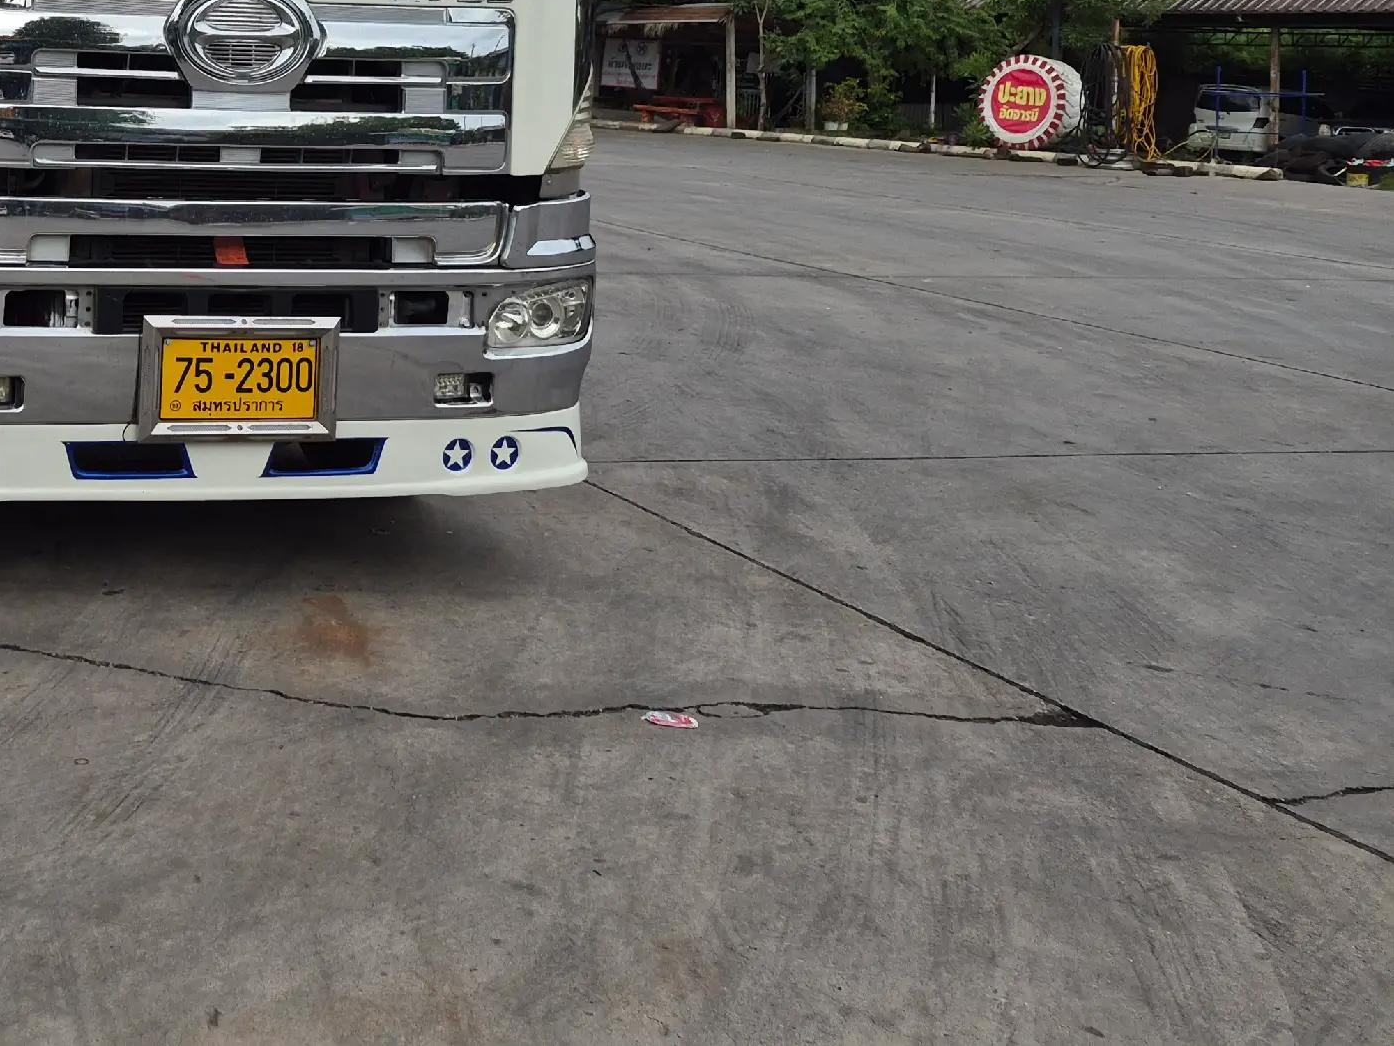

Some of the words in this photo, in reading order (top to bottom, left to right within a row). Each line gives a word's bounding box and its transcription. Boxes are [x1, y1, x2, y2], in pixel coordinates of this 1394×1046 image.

[998, 81, 1047, 107] ปะยาง
[200, 341, 283, 354] THAILAND
[291, 341, 304, 354] 18
[173, 356, 314, 395] 75-2300
[192, 397, 284, 417] สมุทรปราการ
